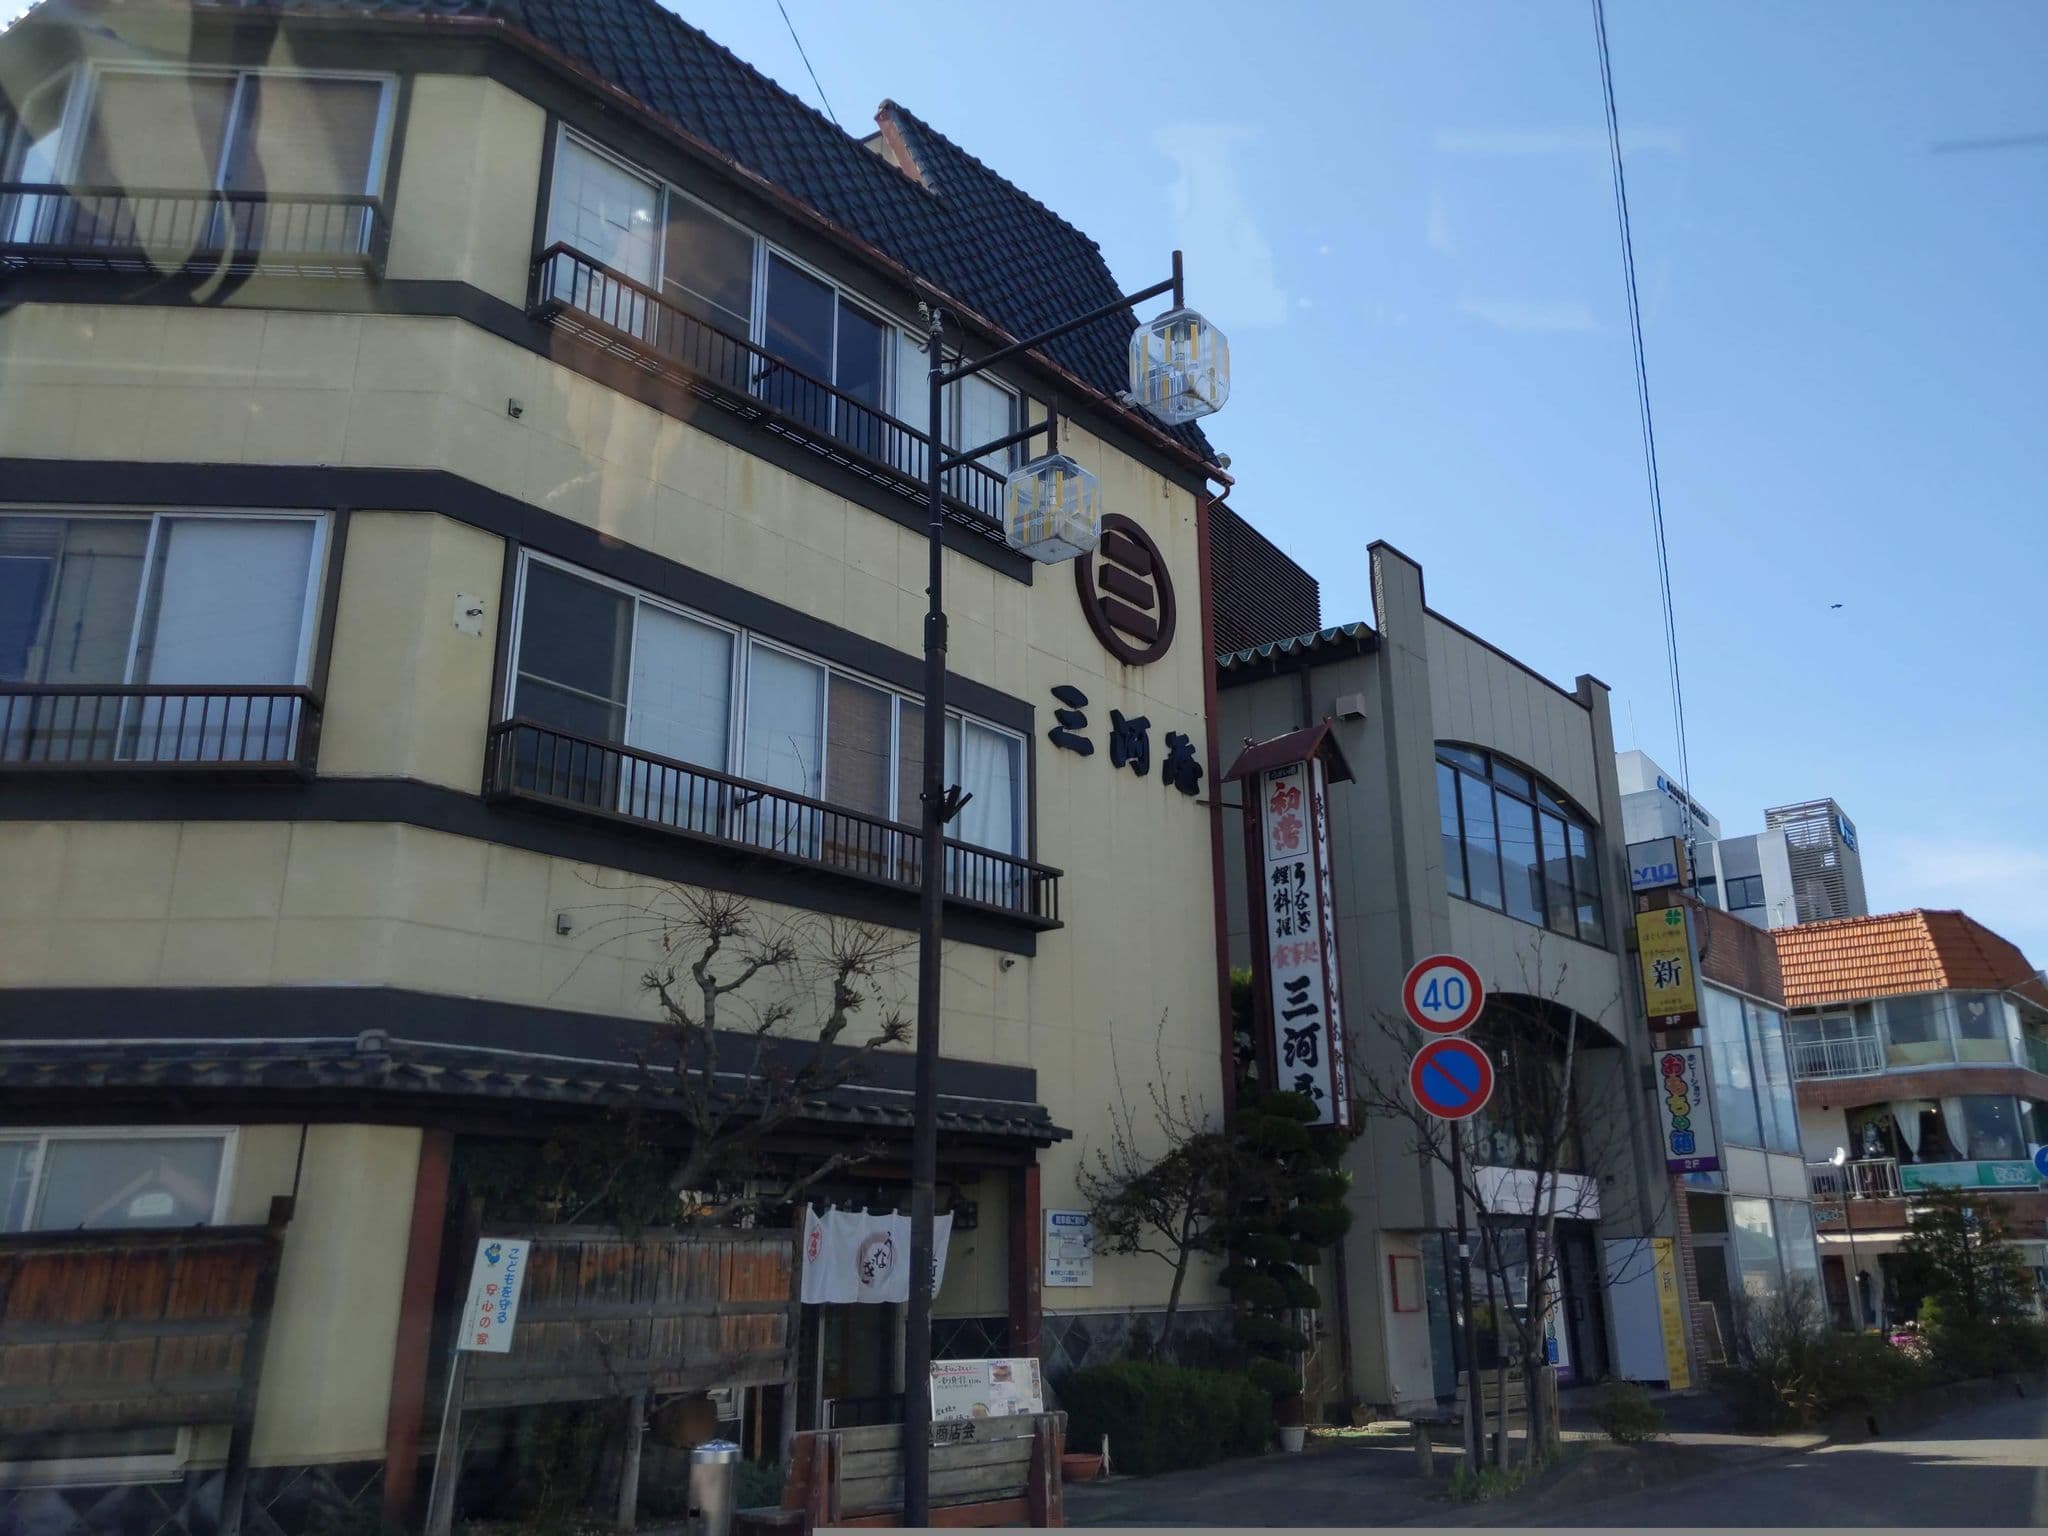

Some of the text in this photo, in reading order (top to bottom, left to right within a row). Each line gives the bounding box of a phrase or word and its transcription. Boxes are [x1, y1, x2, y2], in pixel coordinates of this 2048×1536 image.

[1270, 865, 1293, 938] 鯉料理
[1294, 862, 1311, 933] うなぎ
[1422, 976, 1465, 1012] 40
[1652, 957, 1682, 989] 新
[1660, 1053, 1696, 1156] おもちゃ箱
[1687, 1054, 1701, 1107] ホビーショップ
[1684, 1159, 1700, 1169] 2F
[497, 1248, 520, 1324] こどもを守る
[861, 1231, 894, 1285] うなぎ
[476, 1284, 498, 1345] 安心の家
